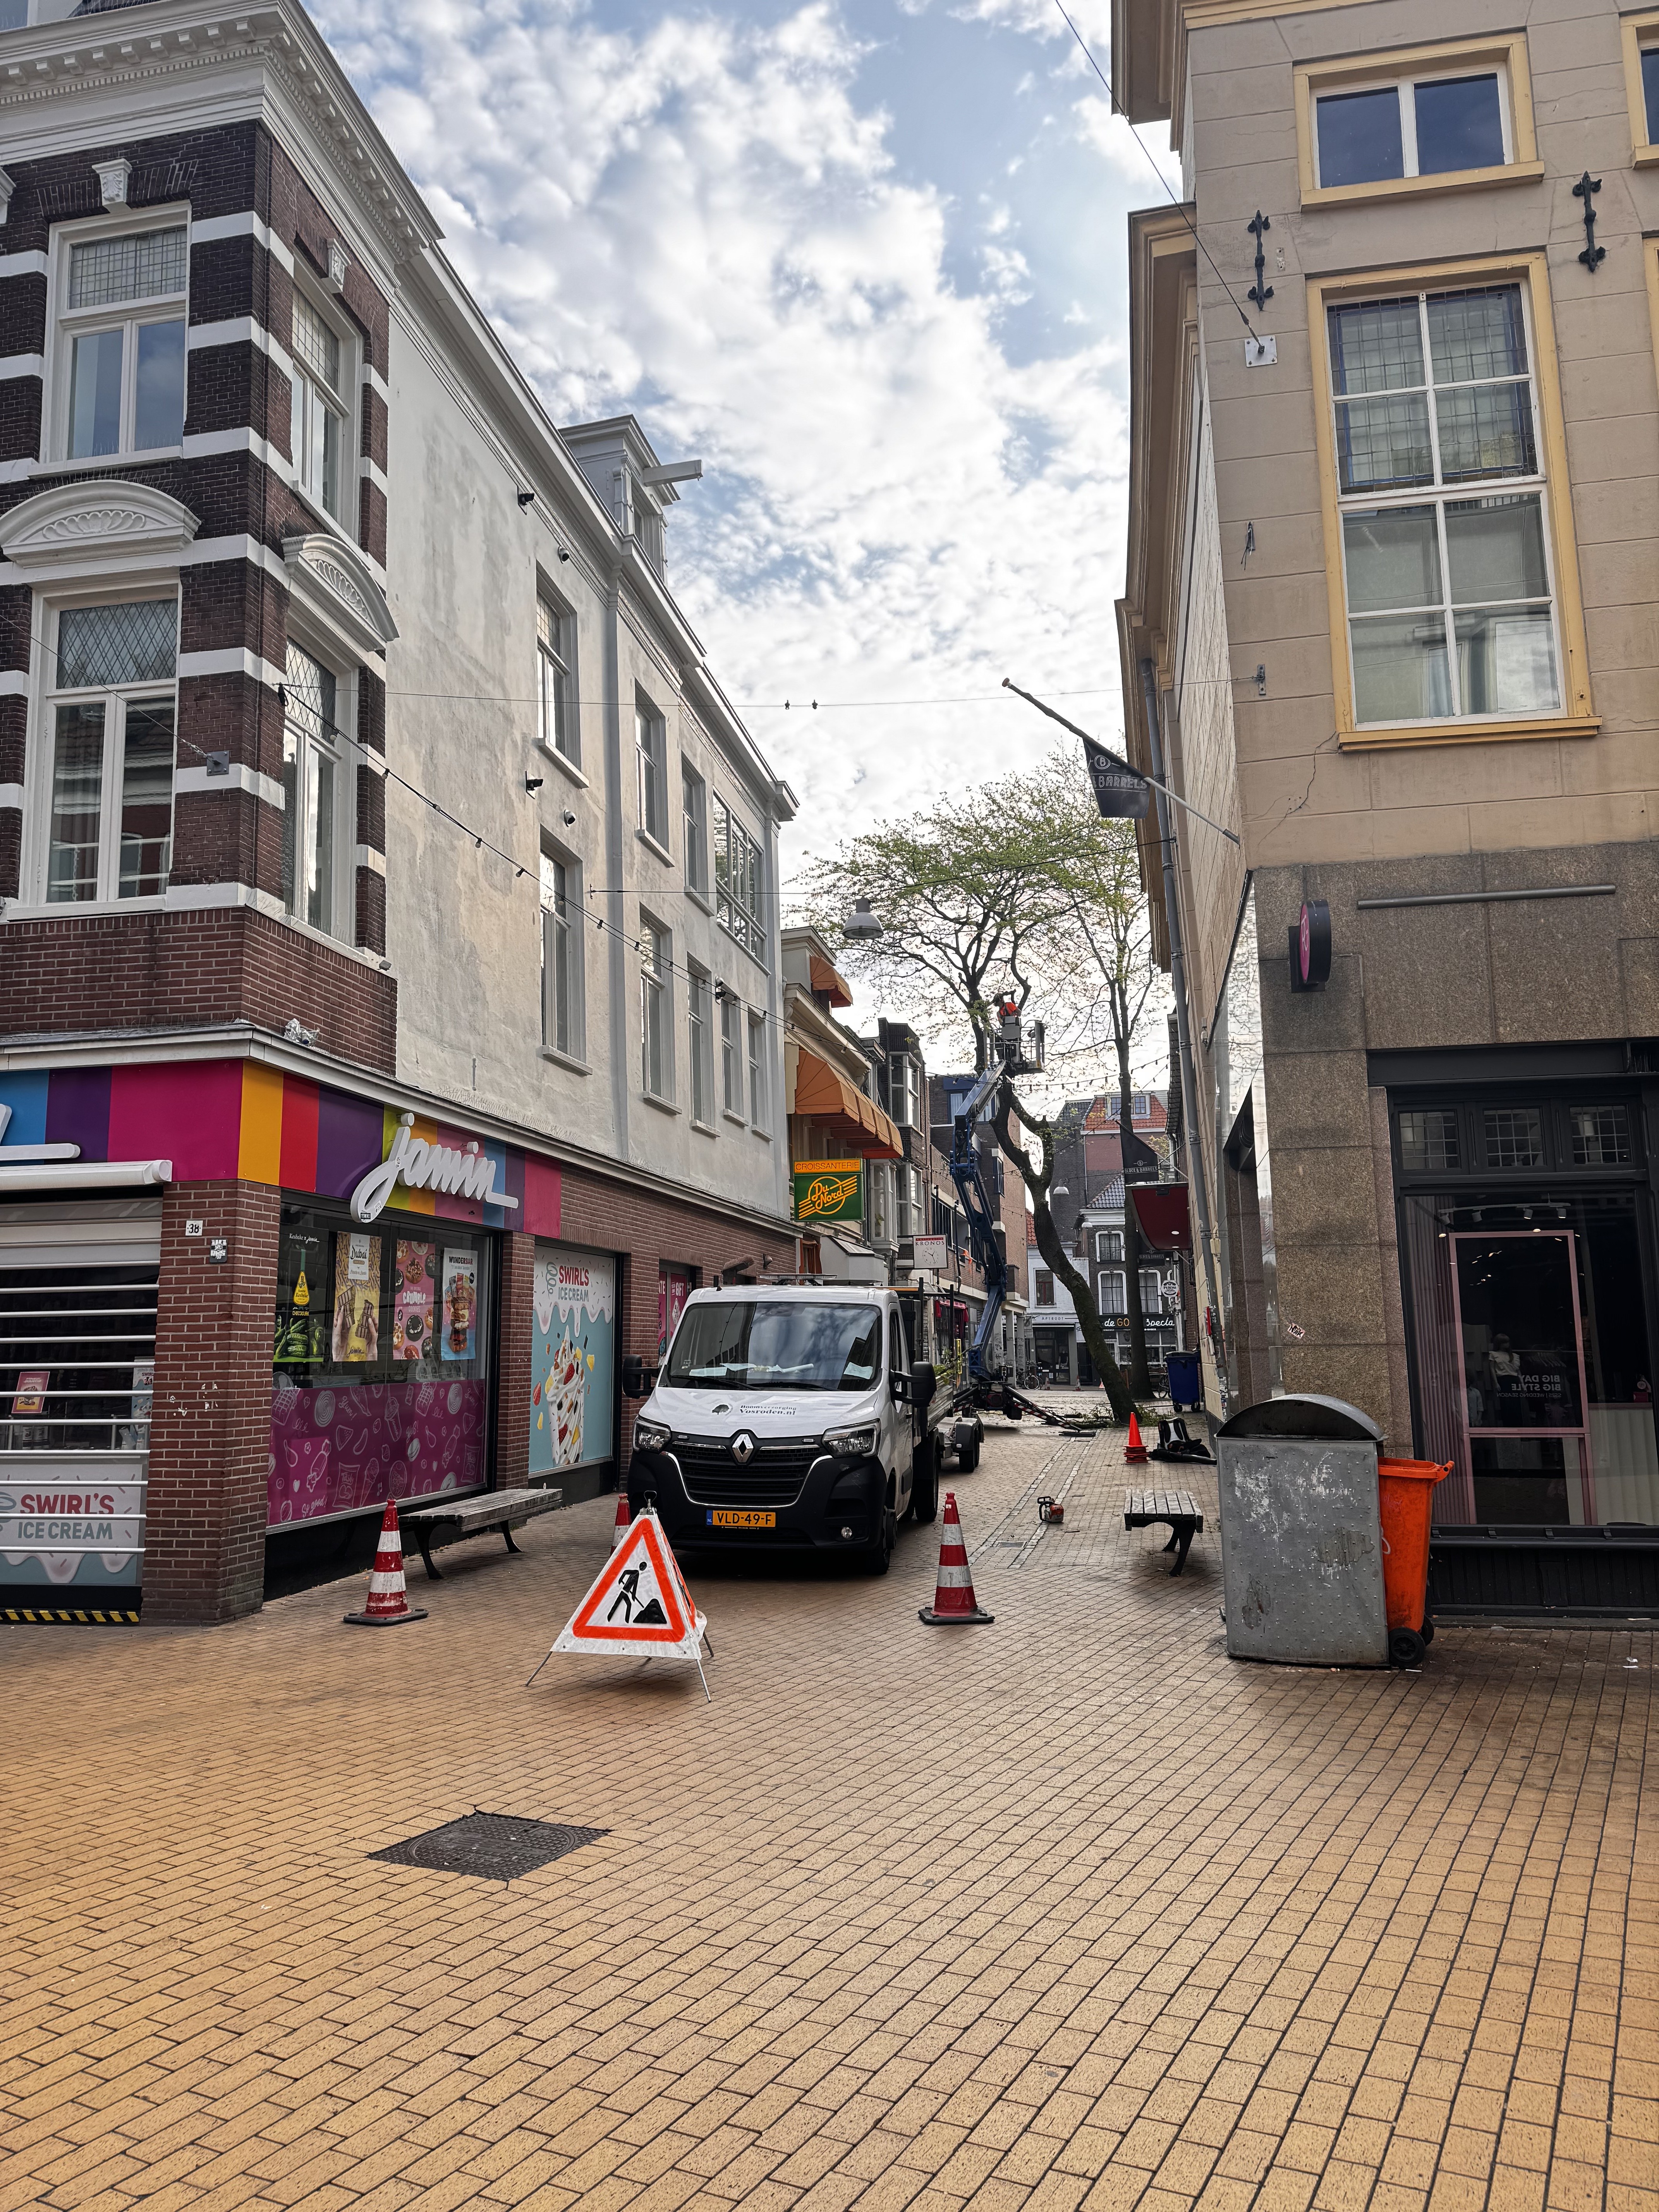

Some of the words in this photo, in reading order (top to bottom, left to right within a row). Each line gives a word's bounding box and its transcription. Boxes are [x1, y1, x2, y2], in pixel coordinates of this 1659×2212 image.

[1098, 776, 1147, 789] BARRELS
[796, 1162, 859, 1170] CROISSANTERIE
[811, 1183, 830, 1201] Du
[815, 1185, 844, 1210] Nord
[189, 1223, 199, 1233] 38
[350, 1245, 367, 1260] Dubai
[449, 1256, 473, 1265] WUNDERBAR
[558, 1286, 567, 1300] ICE
[568, 1288, 589, 1302] CREAM
[675, 1282, 684, 1297] GIFT
[1104, 1318, 1115, 1326] de
[302, 1503, 310, 1518] So
[717, 1512, 772, 1525] VLD-49-F
[18, 1522, 45, 1539] ICE
[48, 1522, 113, 1540] CREAM
